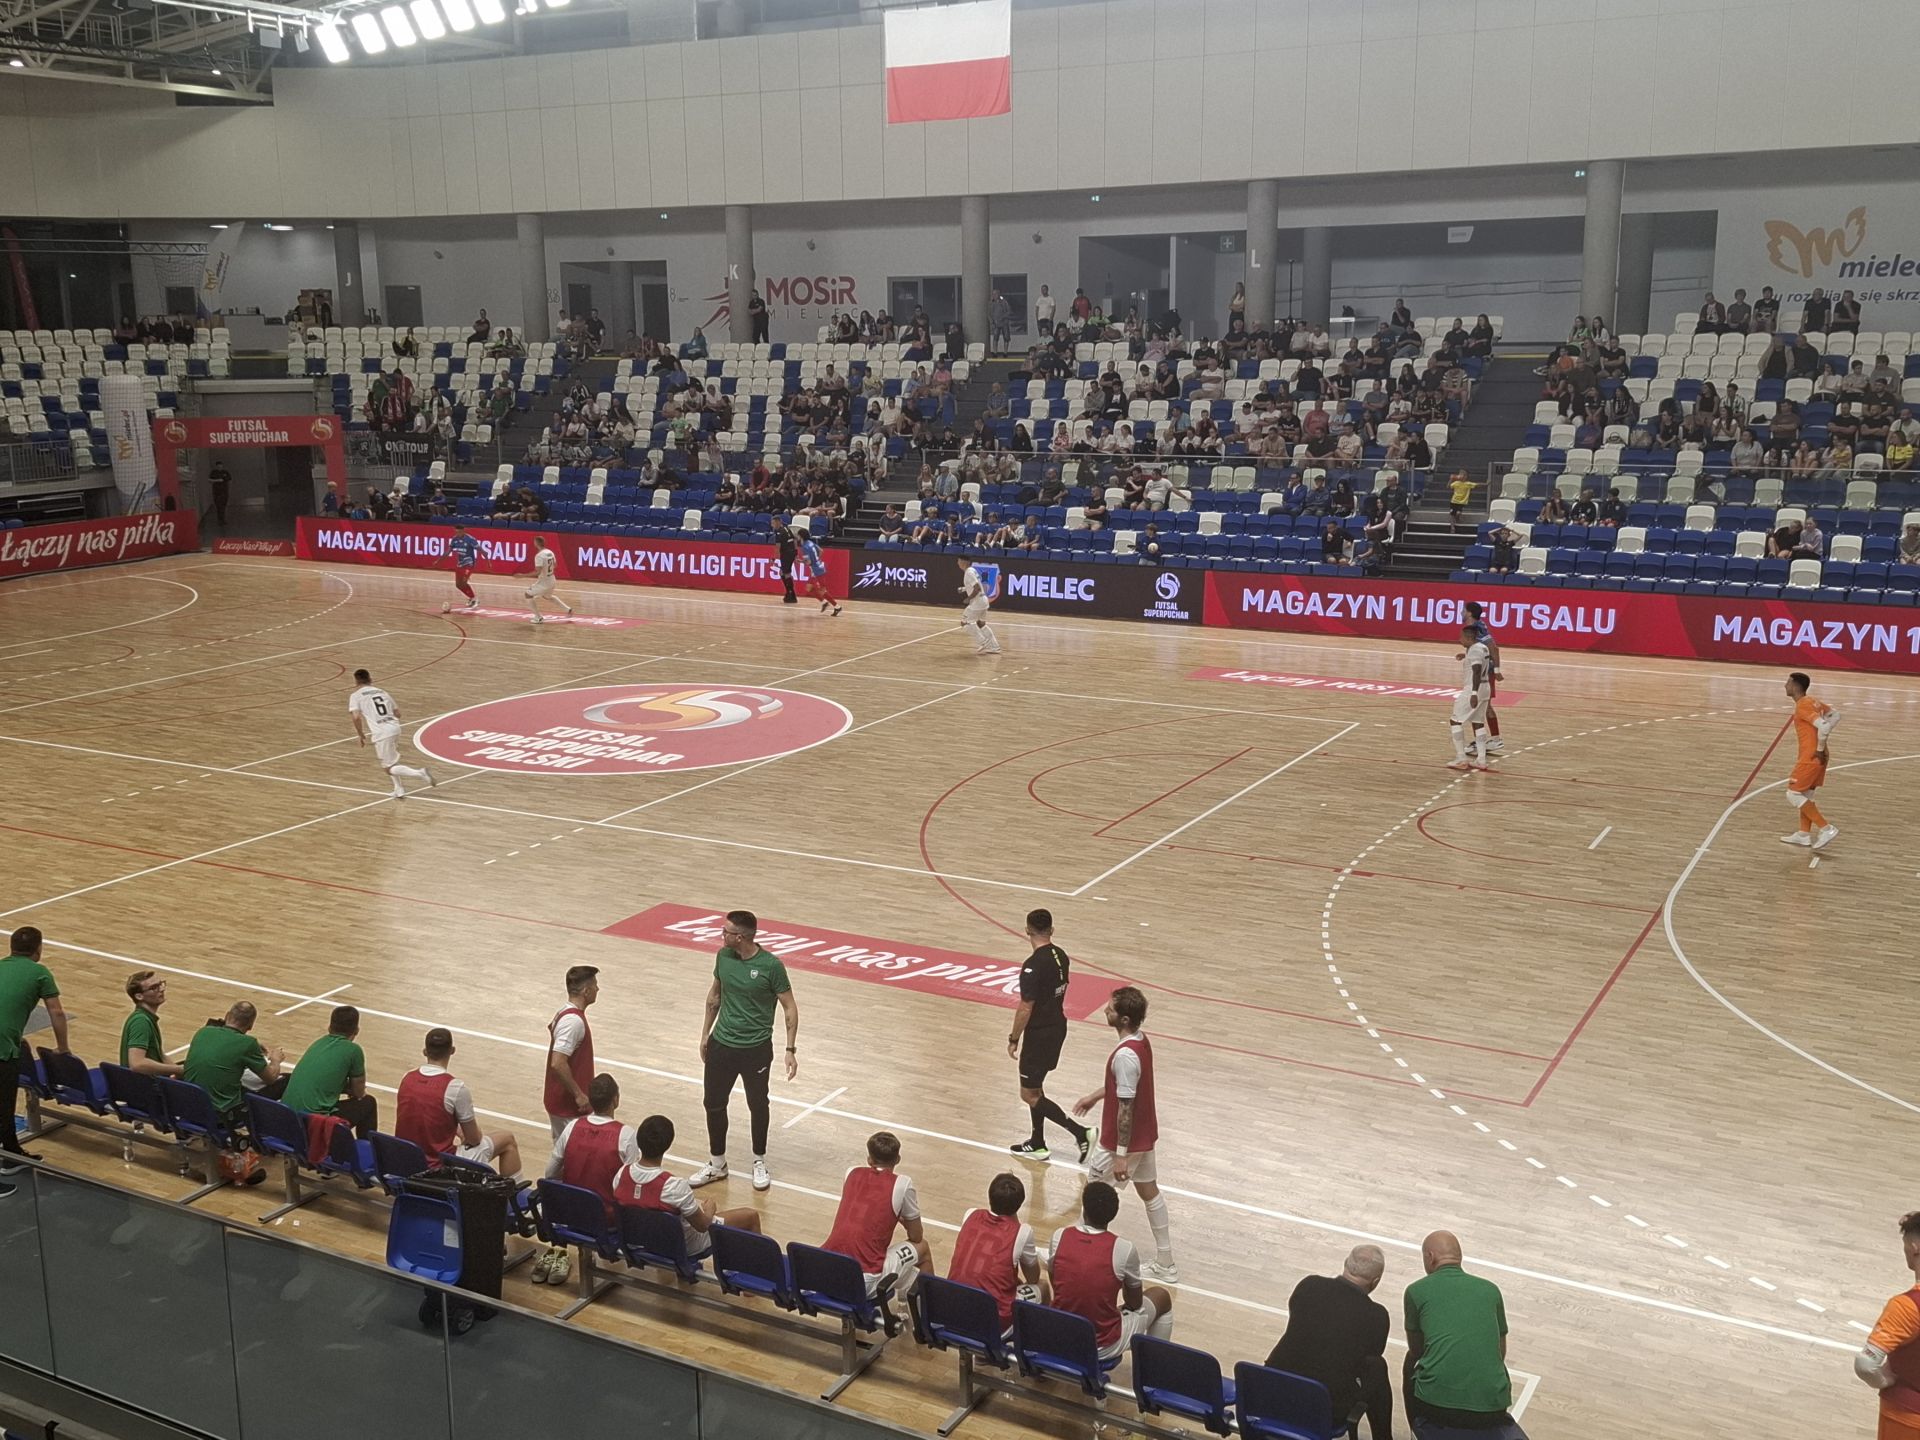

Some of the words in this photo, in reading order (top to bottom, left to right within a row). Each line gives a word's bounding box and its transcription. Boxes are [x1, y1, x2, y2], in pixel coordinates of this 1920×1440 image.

[729, 264, 739, 280] K
[1859, 289, 1883, 304] się
[1886, 289, 1920, 303] skrz
[209, 431, 289, 444] SUPERPUCHAR
[228, 420, 268, 432] FUTSAL
[0, 531, 73, 567] Łączy
[77, 528, 119, 554] nas
[117, 514, 175, 559] piłka
[318, 529, 400, 552] MAGAZYN
[404, 535, 411, 553] 1
[414, 536, 445, 556] LIGI
[578, 547, 673, 573] MAGAZYN
[677, 553, 685, 573] 1
[689, 555, 725, 576] LIGI
[1007, 574, 1096, 601] MIELEC
[1143, 609, 1189, 620] SUPERPUCHAR
[1155, 601, 1178, 610] FUTSAL
[1242, 588, 1386, 620] MAGAZYN
[1392, 596, 1402, 621] 1
[1410, 597, 1465, 625] LIGI
[1713, 614, 1898, 653] MAGAZYN
[1906, 626, 1920, 654] 1
[372, 696, 387, 716] 6
[449, 730, 685, 765] SUPERPUCHAR
[536, 726, 658, 747] FUTSAL
[464, 746, 595, 769] POLSKI
[812, 945, 926, 969] nas
